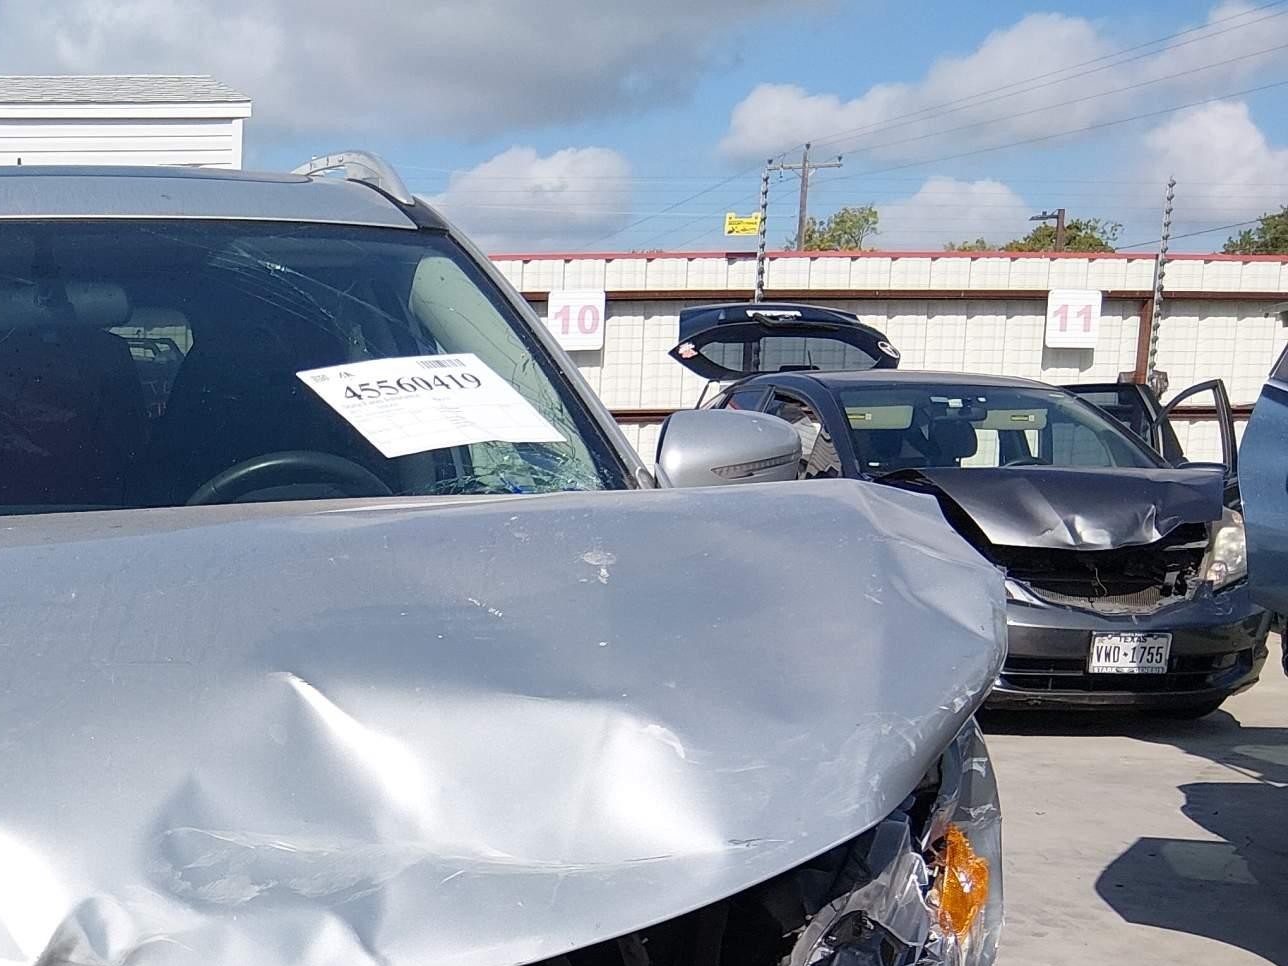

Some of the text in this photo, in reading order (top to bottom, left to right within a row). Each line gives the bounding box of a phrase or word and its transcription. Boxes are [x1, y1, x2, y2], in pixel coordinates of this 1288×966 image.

[554, 305, 600, 335] 10
[1053, 304, 1092, 332] 11
[344, 372, 482, 401] 45560419
[1119, 636, 1147, 644] TEXAS
